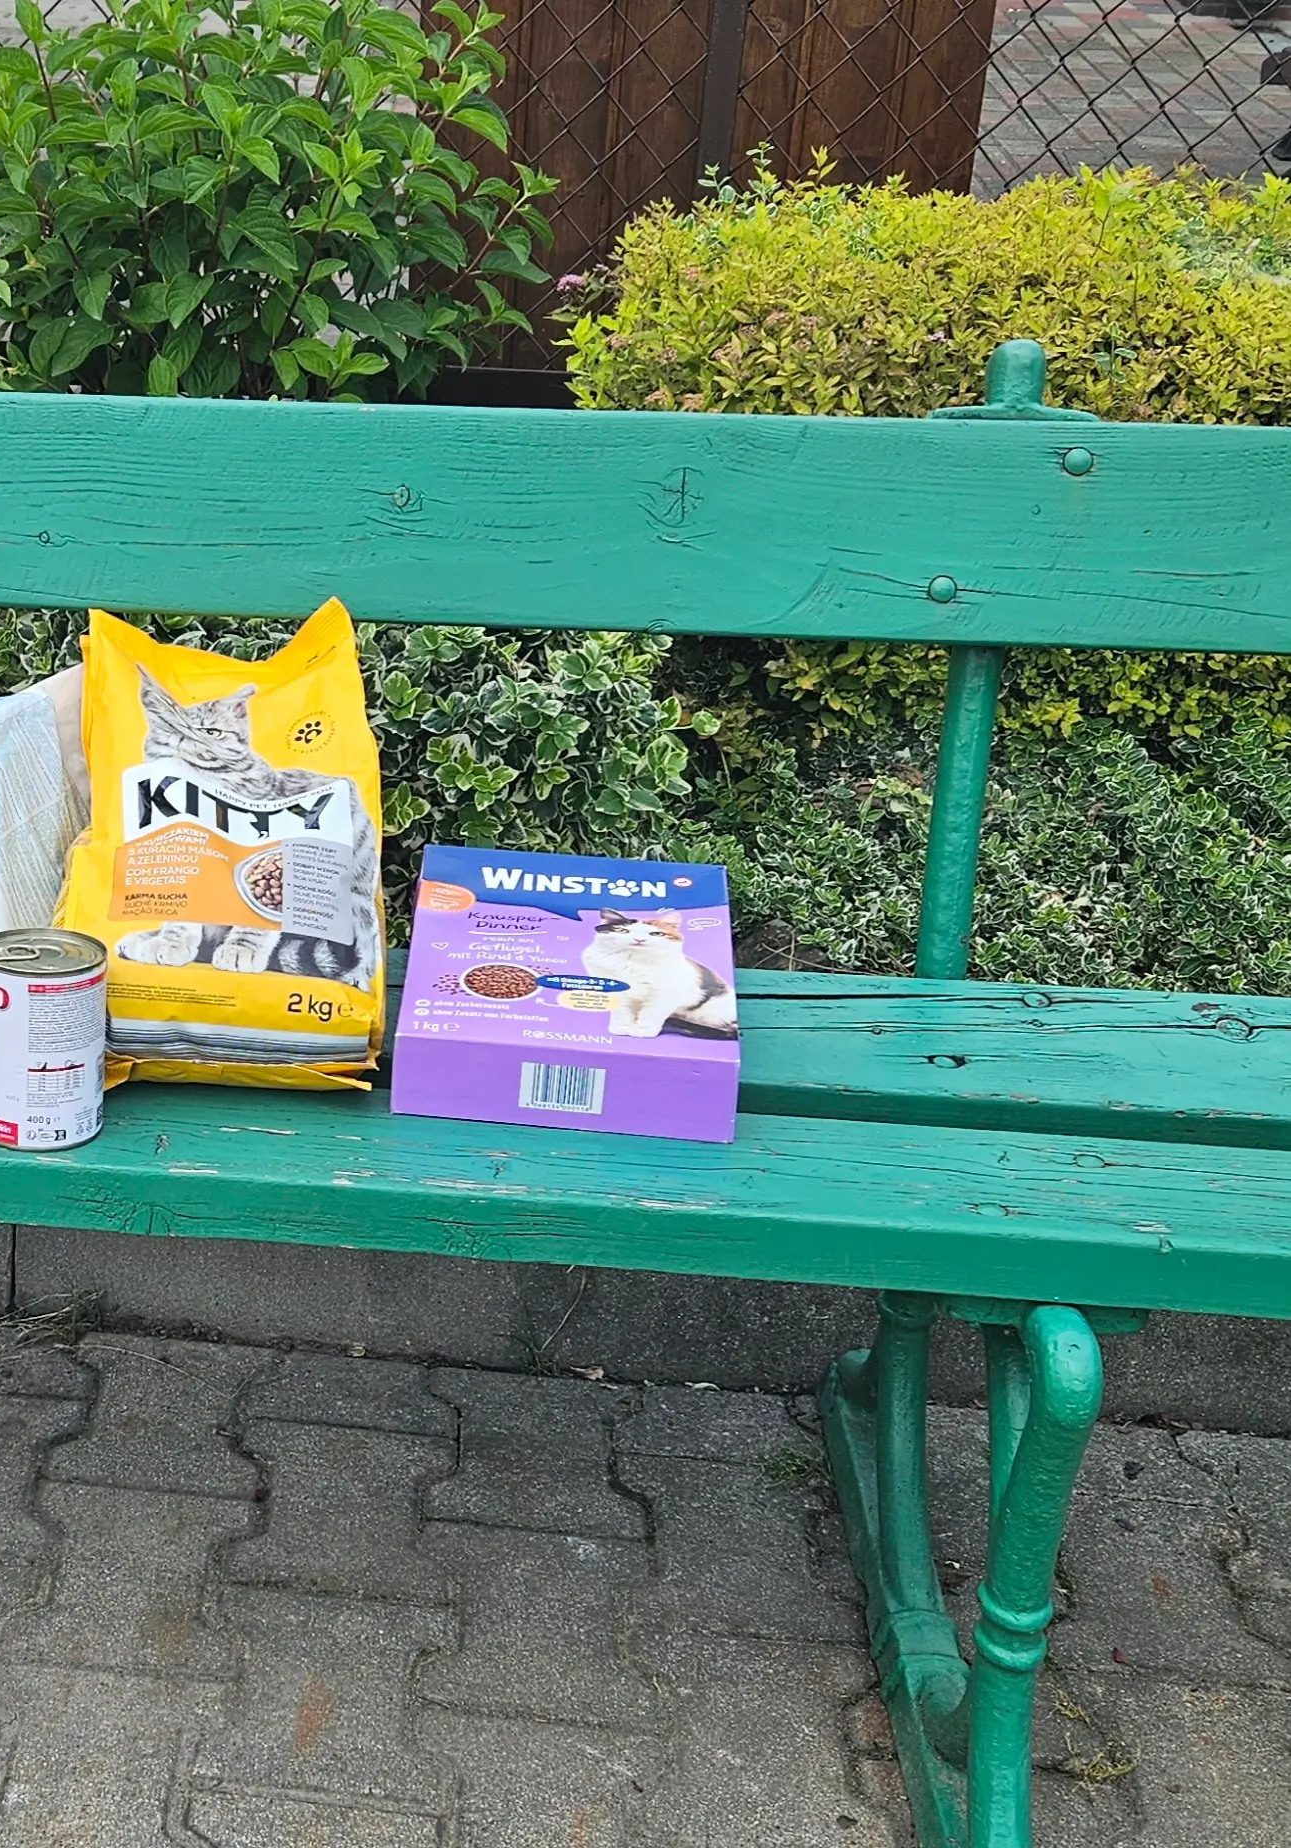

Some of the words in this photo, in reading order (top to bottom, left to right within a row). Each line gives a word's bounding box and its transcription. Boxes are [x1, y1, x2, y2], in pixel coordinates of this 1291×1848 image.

[136, 775, 335, 840] KITTY
[137, 854, 198, 865] ZELENINOU
[125, 867, 151, 877] COM
[153, 866, 200, 876] FRANGO
[124, 877, 132, 886] E
[134, 875, 187, 886] VEGETAIS
[124, 893, 156, 901] KARMA
[157, 892, 188, 900] SUCHA
[467, 911, 561, 924] Knusper-
[475, 920, 542, 931] Dinner
[447, 952, 473, 960] mit
[476, 951, 512, 961] Rind
[287, 993, 303, 1013] 2
[307, 994, 334, 1022] kg
[423, 1021, 440, 1033] kg
[522, 1029, 613, 1045] ROSSMANN
[26, 1115, 44, 1124] 400
